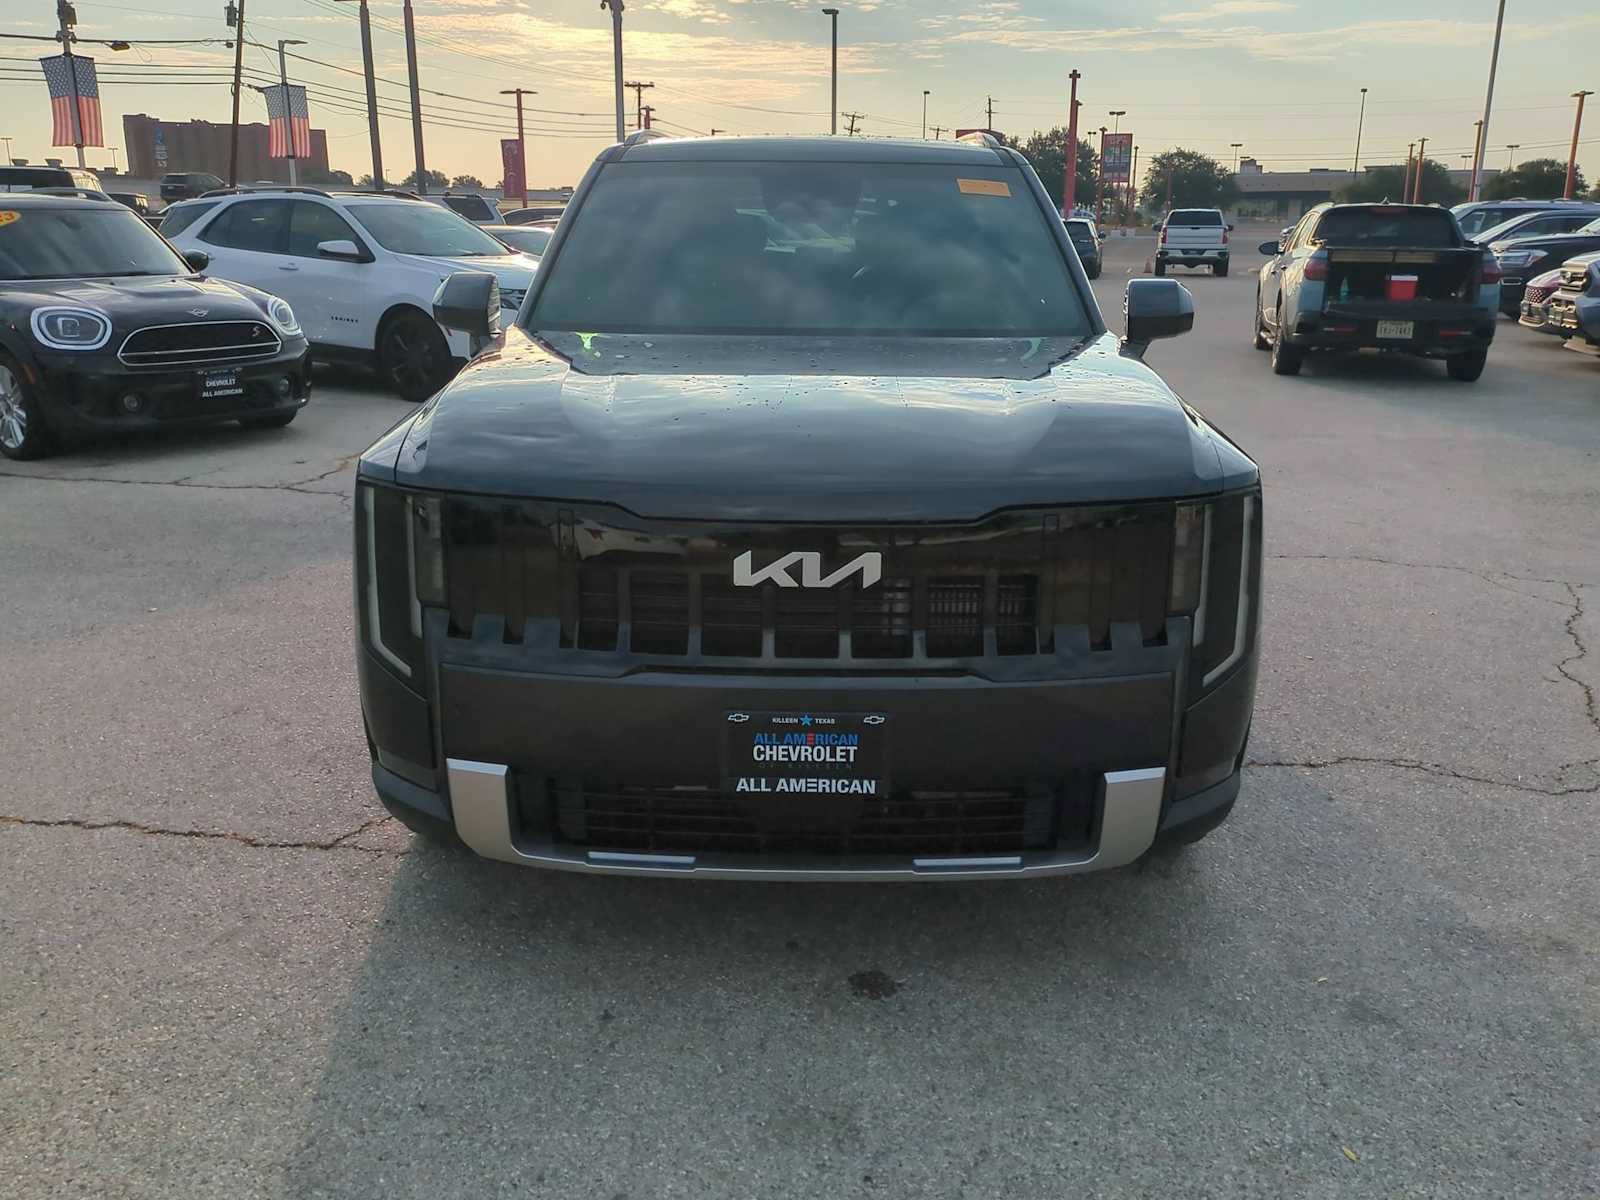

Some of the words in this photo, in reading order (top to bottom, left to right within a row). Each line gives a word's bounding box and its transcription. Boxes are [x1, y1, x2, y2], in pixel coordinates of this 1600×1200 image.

[753, 733, 781, 745] ALL
[783, 733, 859, 746] AMERICAN
[753, 745, 858, 762] CHEVROLET
[735, 777, 772, 792] ALL
[775, 778, 877, 794] AMERICAN
